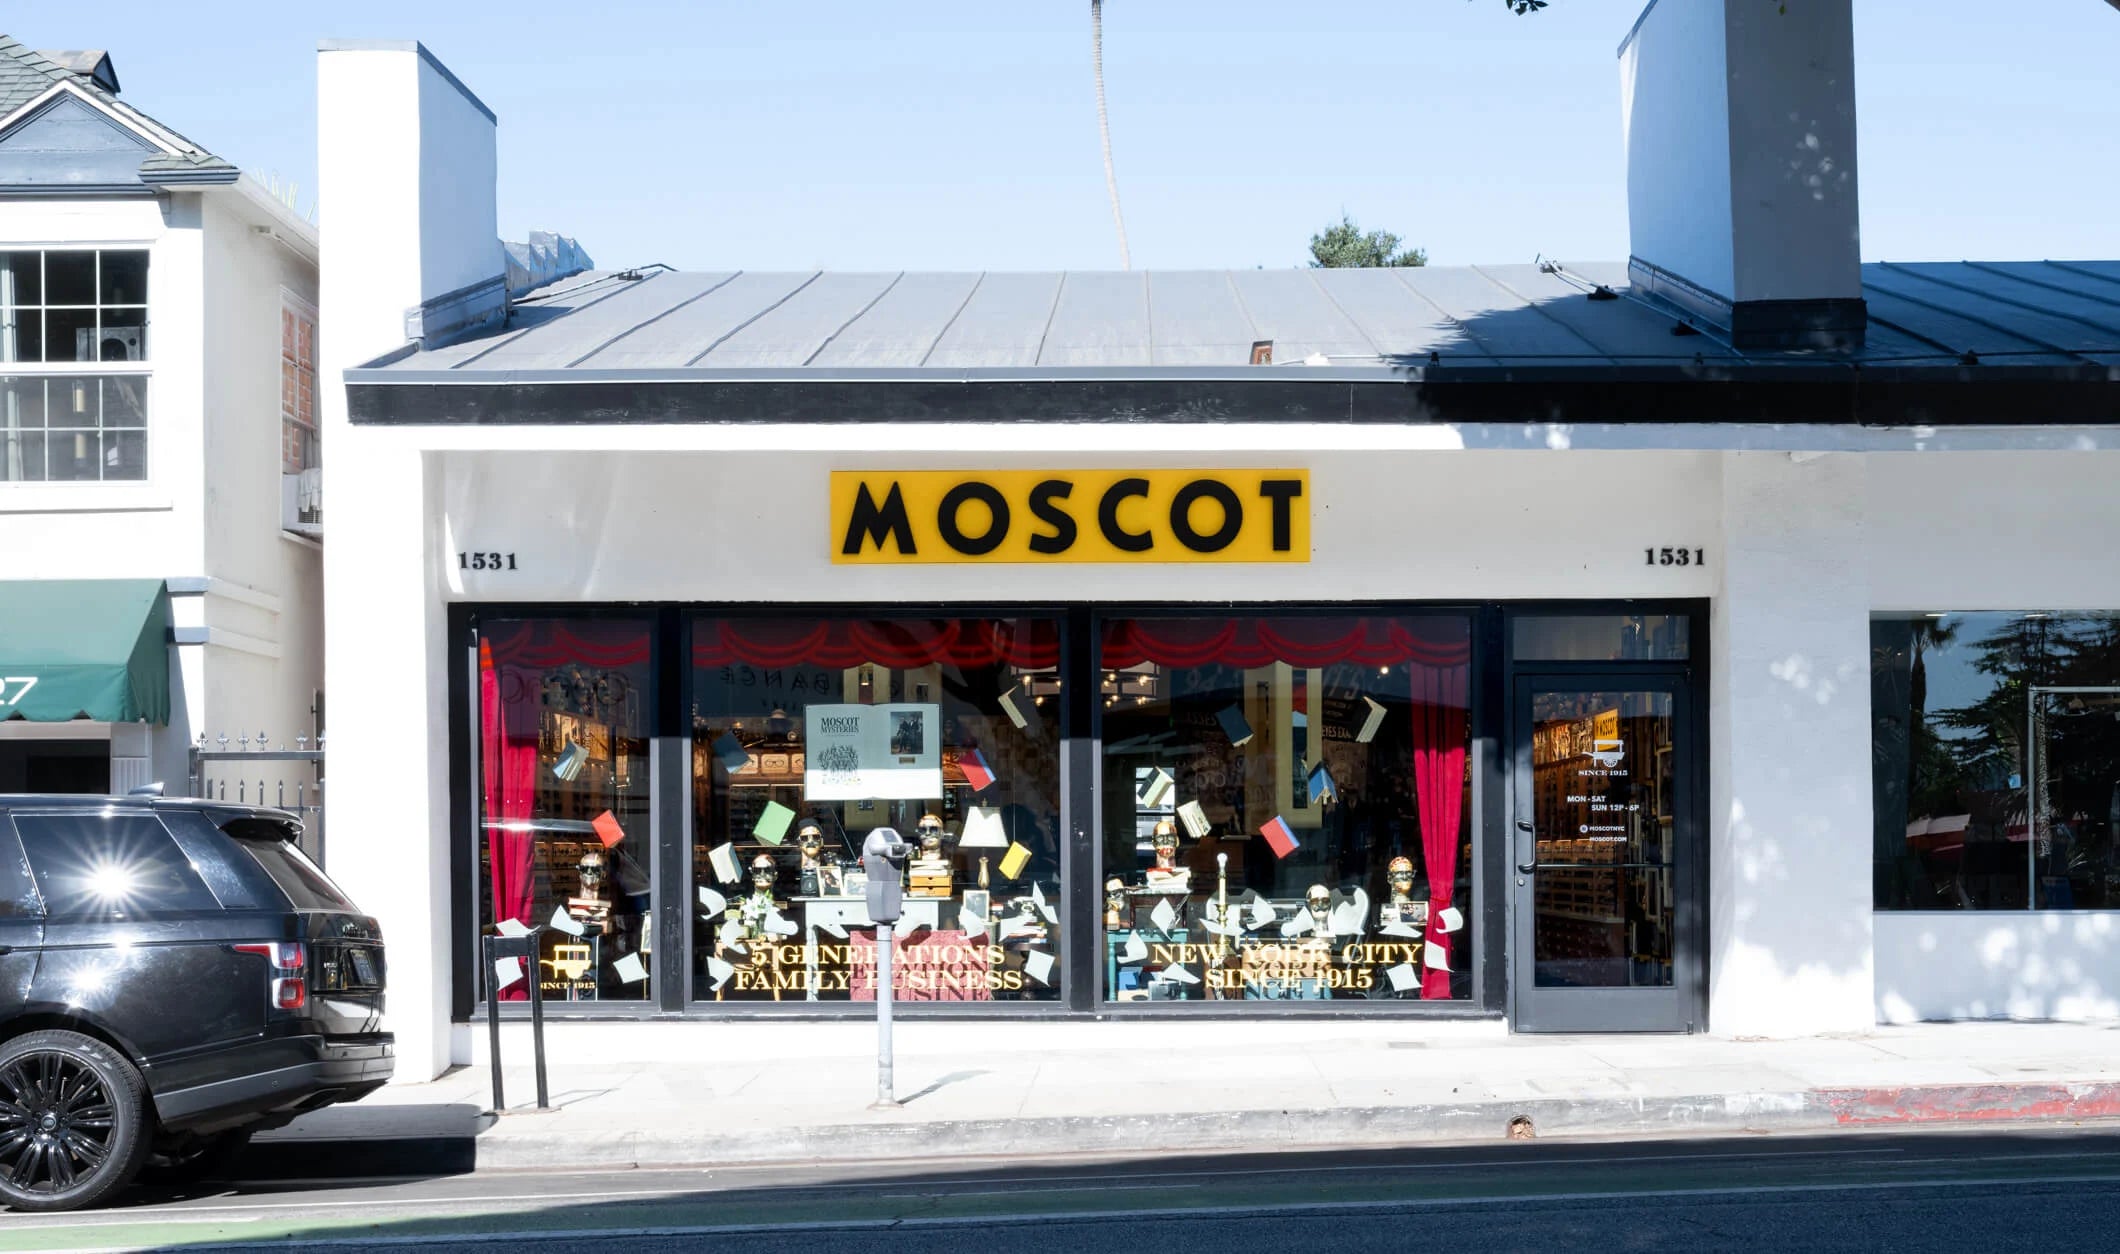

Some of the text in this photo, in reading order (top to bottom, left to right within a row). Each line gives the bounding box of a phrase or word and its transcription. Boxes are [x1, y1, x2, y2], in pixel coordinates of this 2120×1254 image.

[841, 478, 1302, 556] MOSCOT
[457, 551, 518, 570] 1531
[1644, 546, 1704, 567] 1531
[0, 676, 38, 705] 7
[821, 716, 860, 726] MOSCOT
[821, 725, 860, 733] MYSTERIES
[751, 945, 769, 965] 5
[1151, 943, 1423, 964] NEW YORK CITY
[734, 970, 852, 990] FAMILY
[1205, 968, 1373, 989] SINCE 1915
